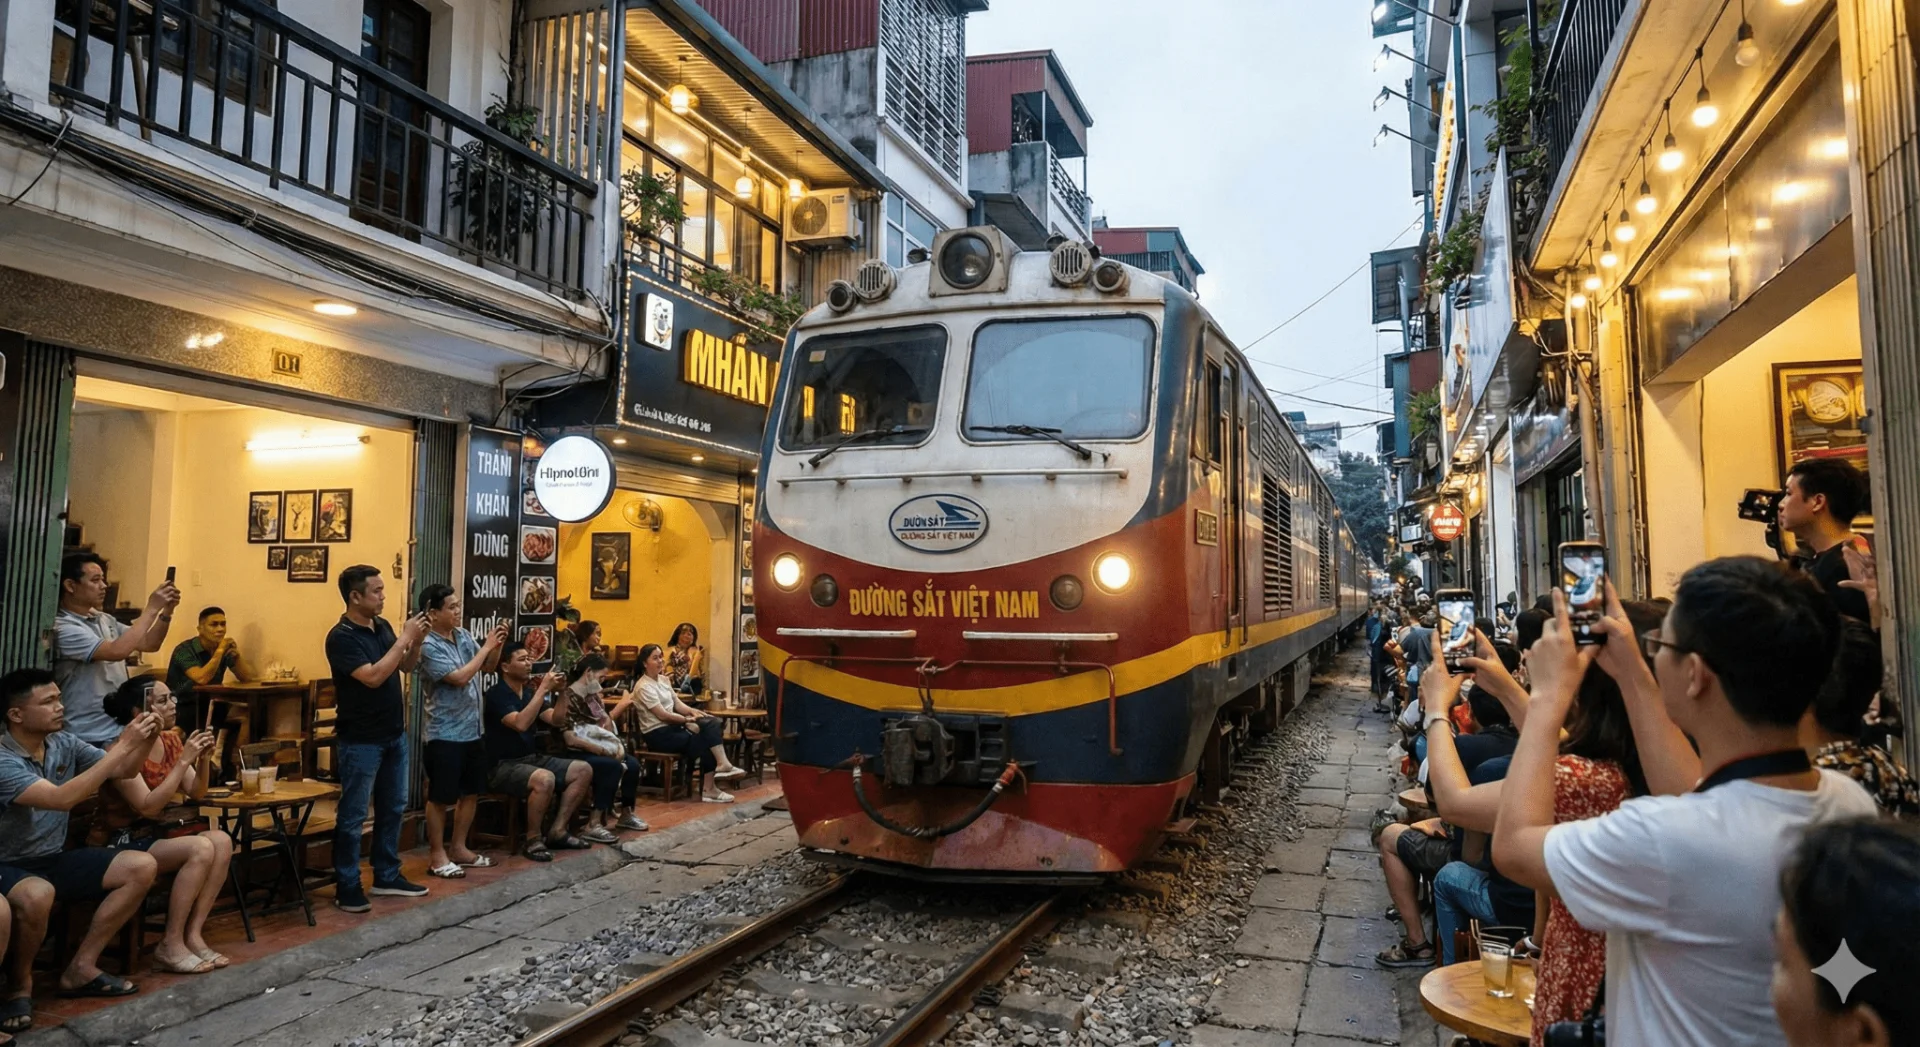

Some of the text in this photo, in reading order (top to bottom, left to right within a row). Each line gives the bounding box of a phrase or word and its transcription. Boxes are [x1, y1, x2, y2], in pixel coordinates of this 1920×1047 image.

[849, 579, 1040, 624] ĐƯỜNG SẮT VIỆT NAM
